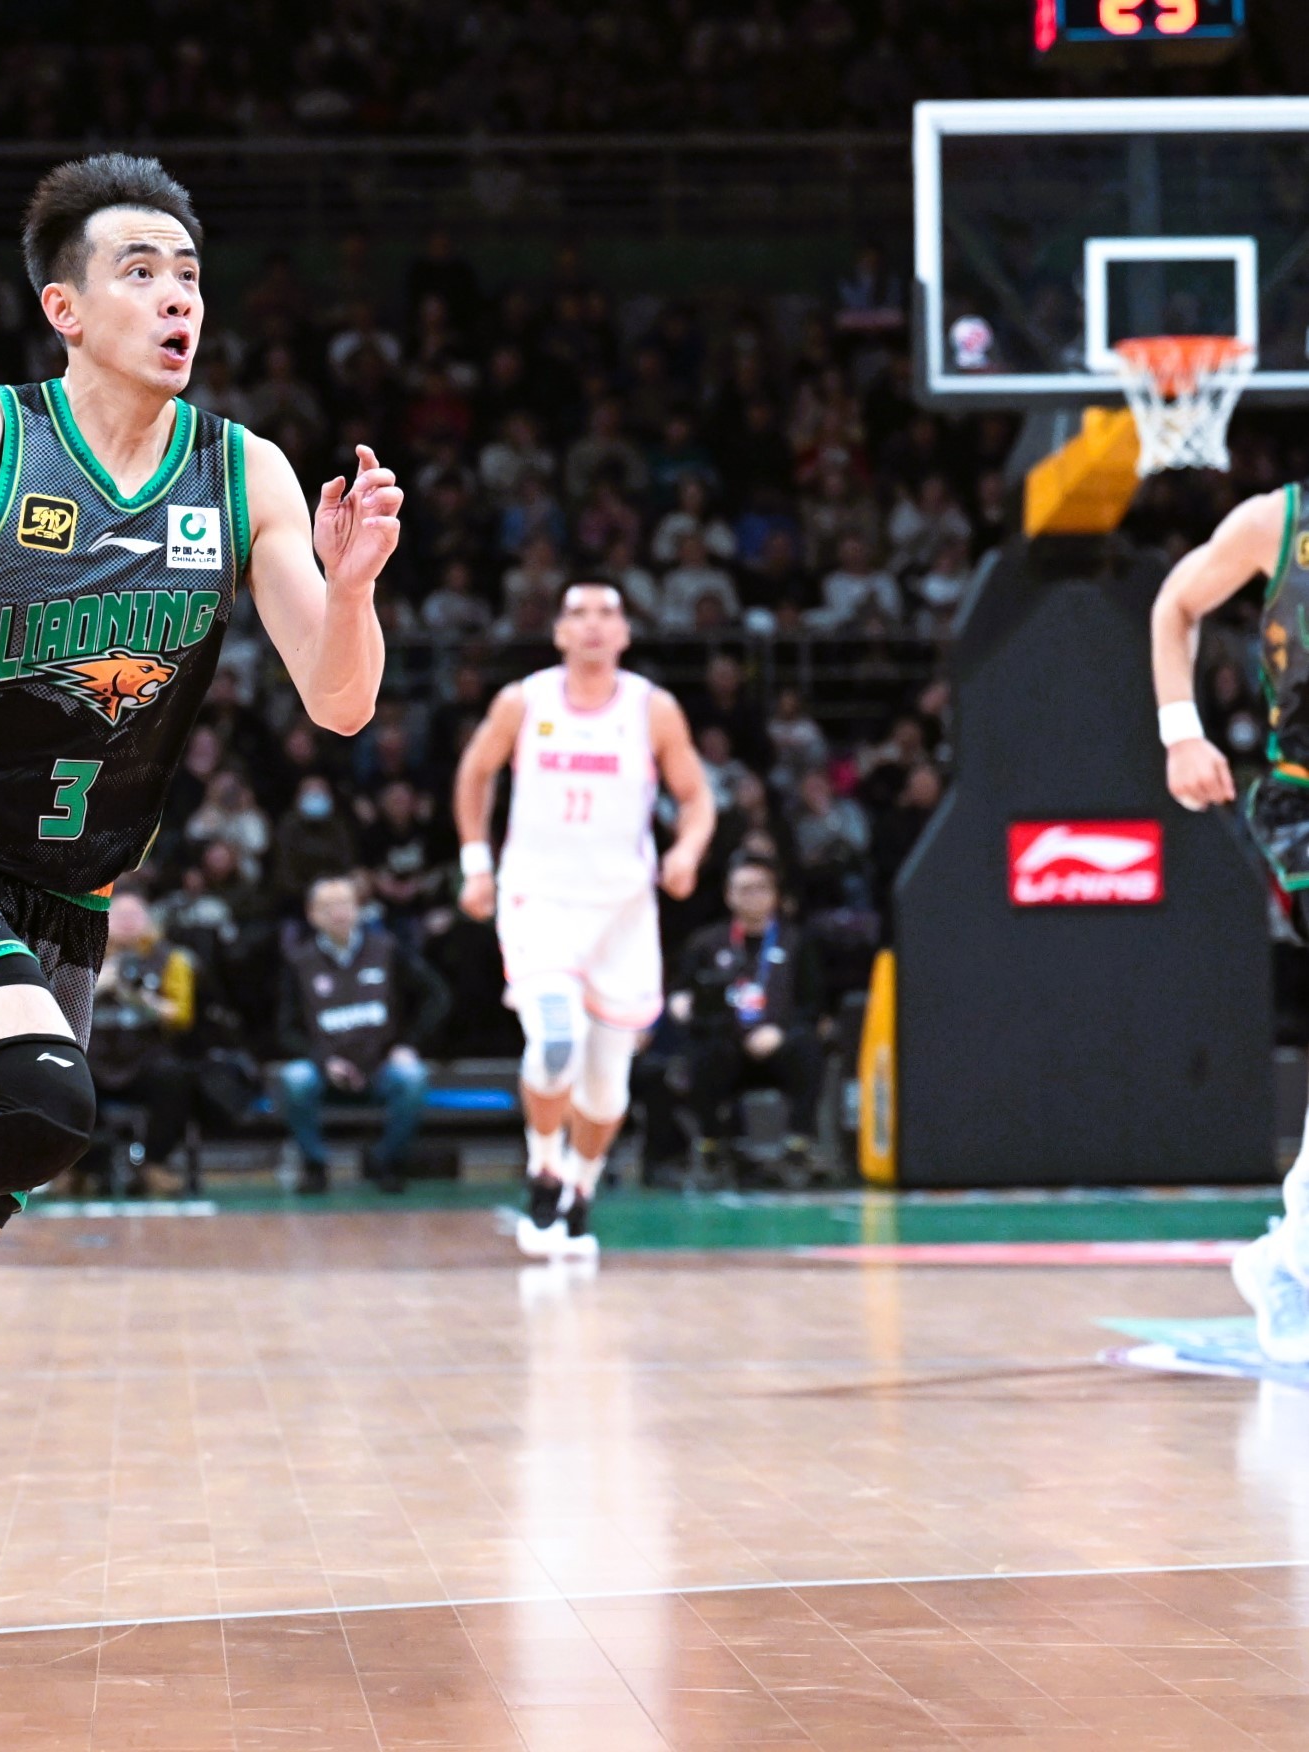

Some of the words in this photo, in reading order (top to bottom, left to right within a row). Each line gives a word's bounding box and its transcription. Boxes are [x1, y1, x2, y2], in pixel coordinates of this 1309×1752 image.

[171, 545, 217, 556] 中国人寿
[38, 758, 104, 841] 3
